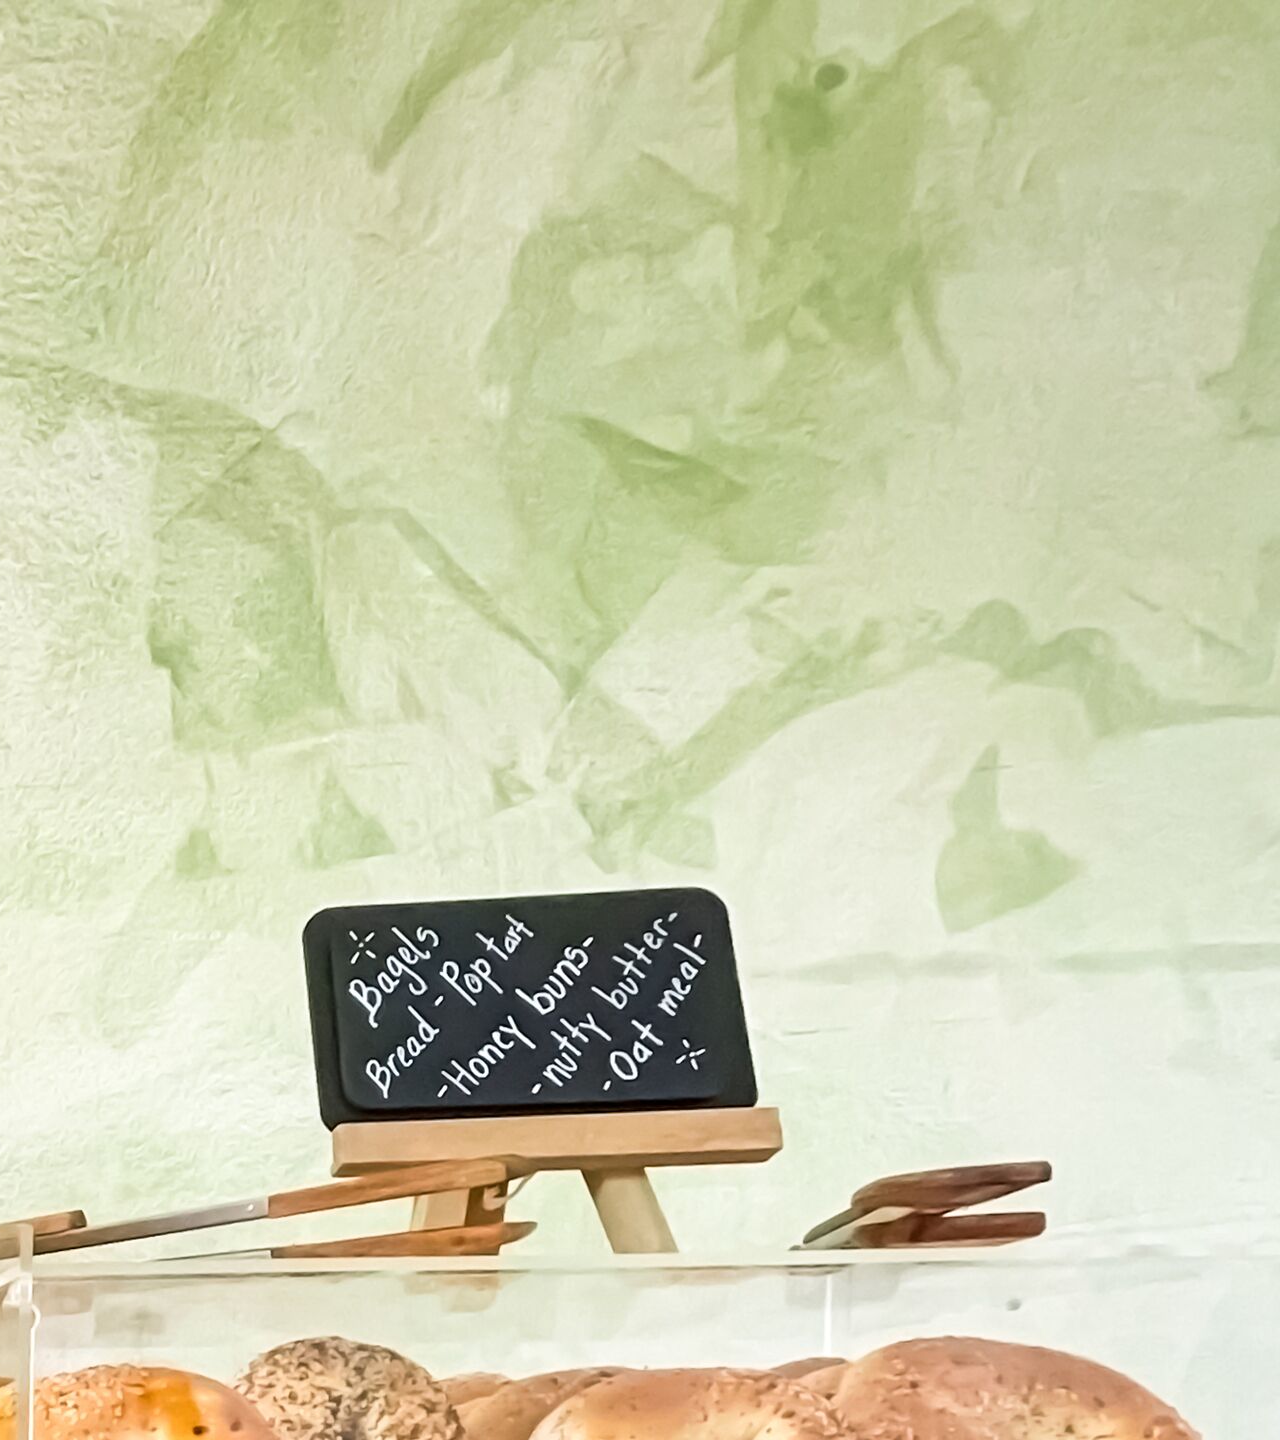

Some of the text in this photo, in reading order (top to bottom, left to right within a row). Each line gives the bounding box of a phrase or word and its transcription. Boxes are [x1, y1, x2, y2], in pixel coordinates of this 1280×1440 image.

[348, 926, 440, 1029] Bagels
[365, 1005, 440, 1100] Bread
[439, 960, 504, 1007] Pop
[474, 913, 535, 962] tart
